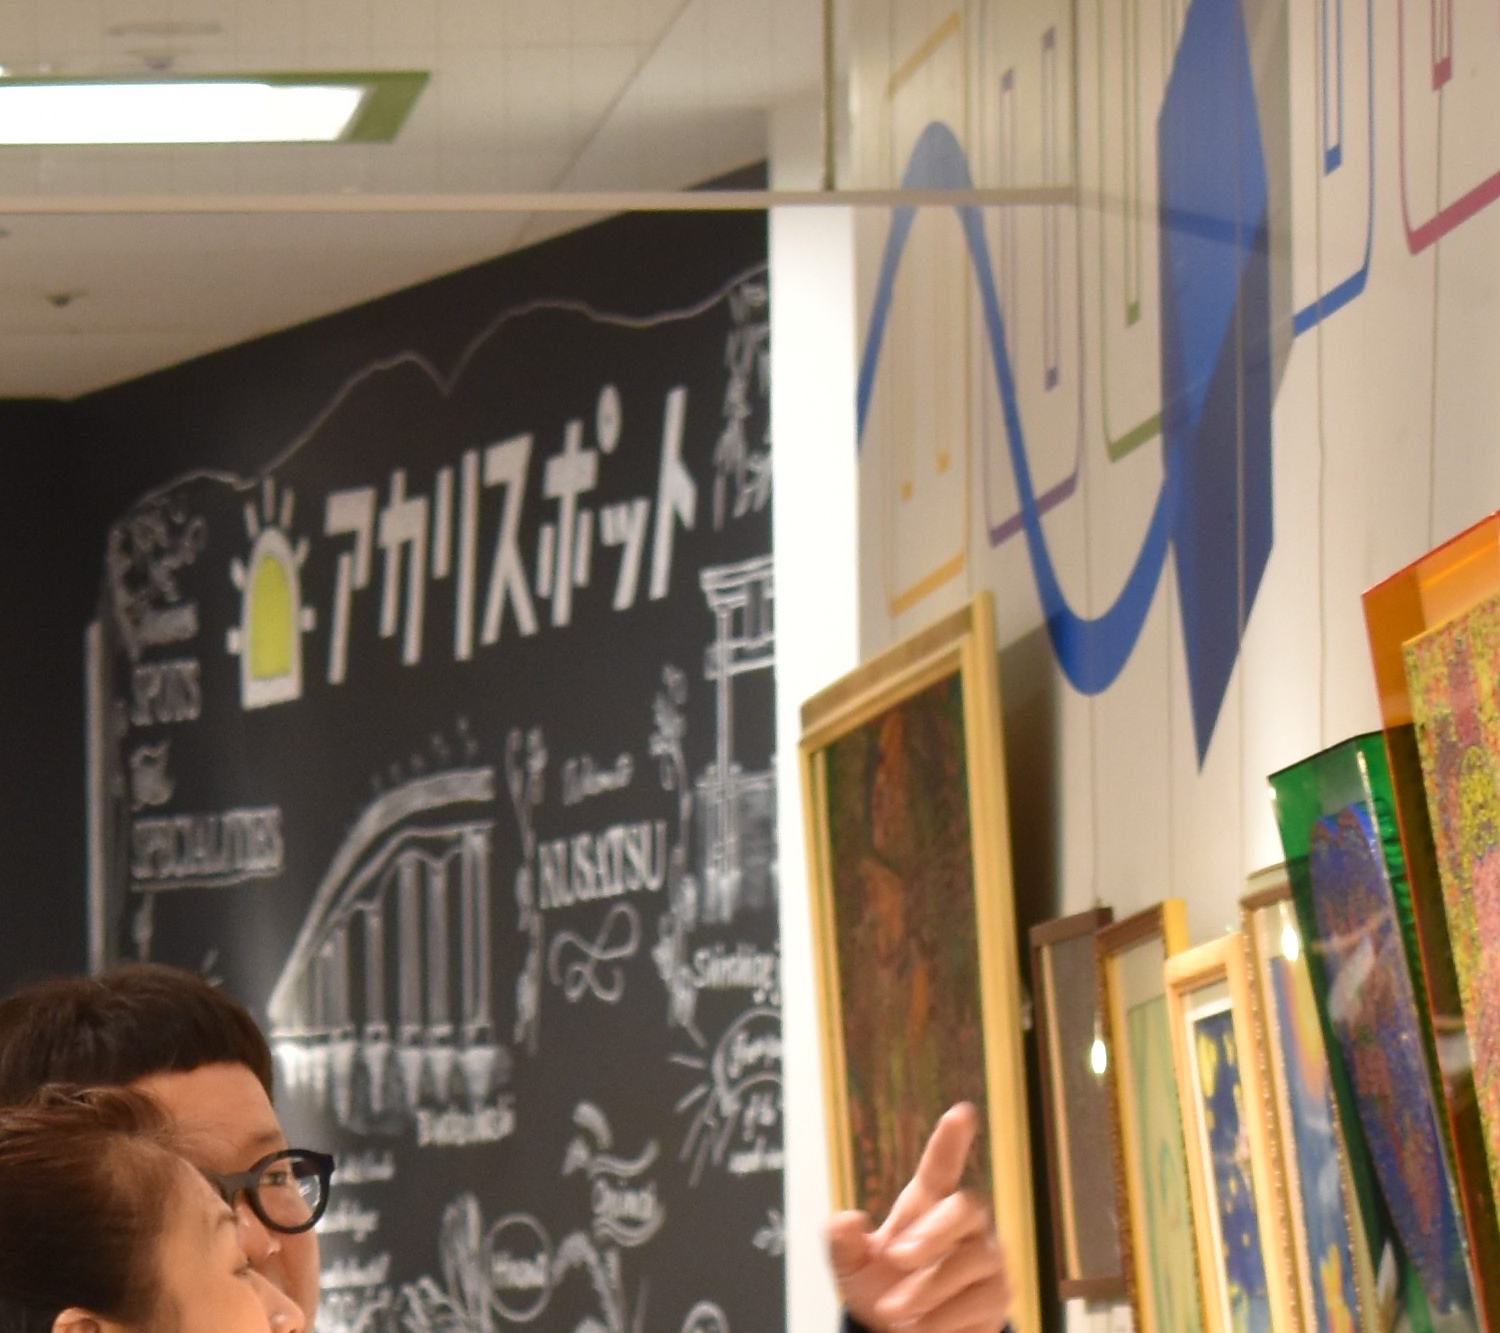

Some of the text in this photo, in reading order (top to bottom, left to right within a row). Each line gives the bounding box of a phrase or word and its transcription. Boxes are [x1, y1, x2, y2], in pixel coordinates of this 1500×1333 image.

[324, 382, 698, 687] アカリスポット
[538, 819, 667, 911] KUSATSU
